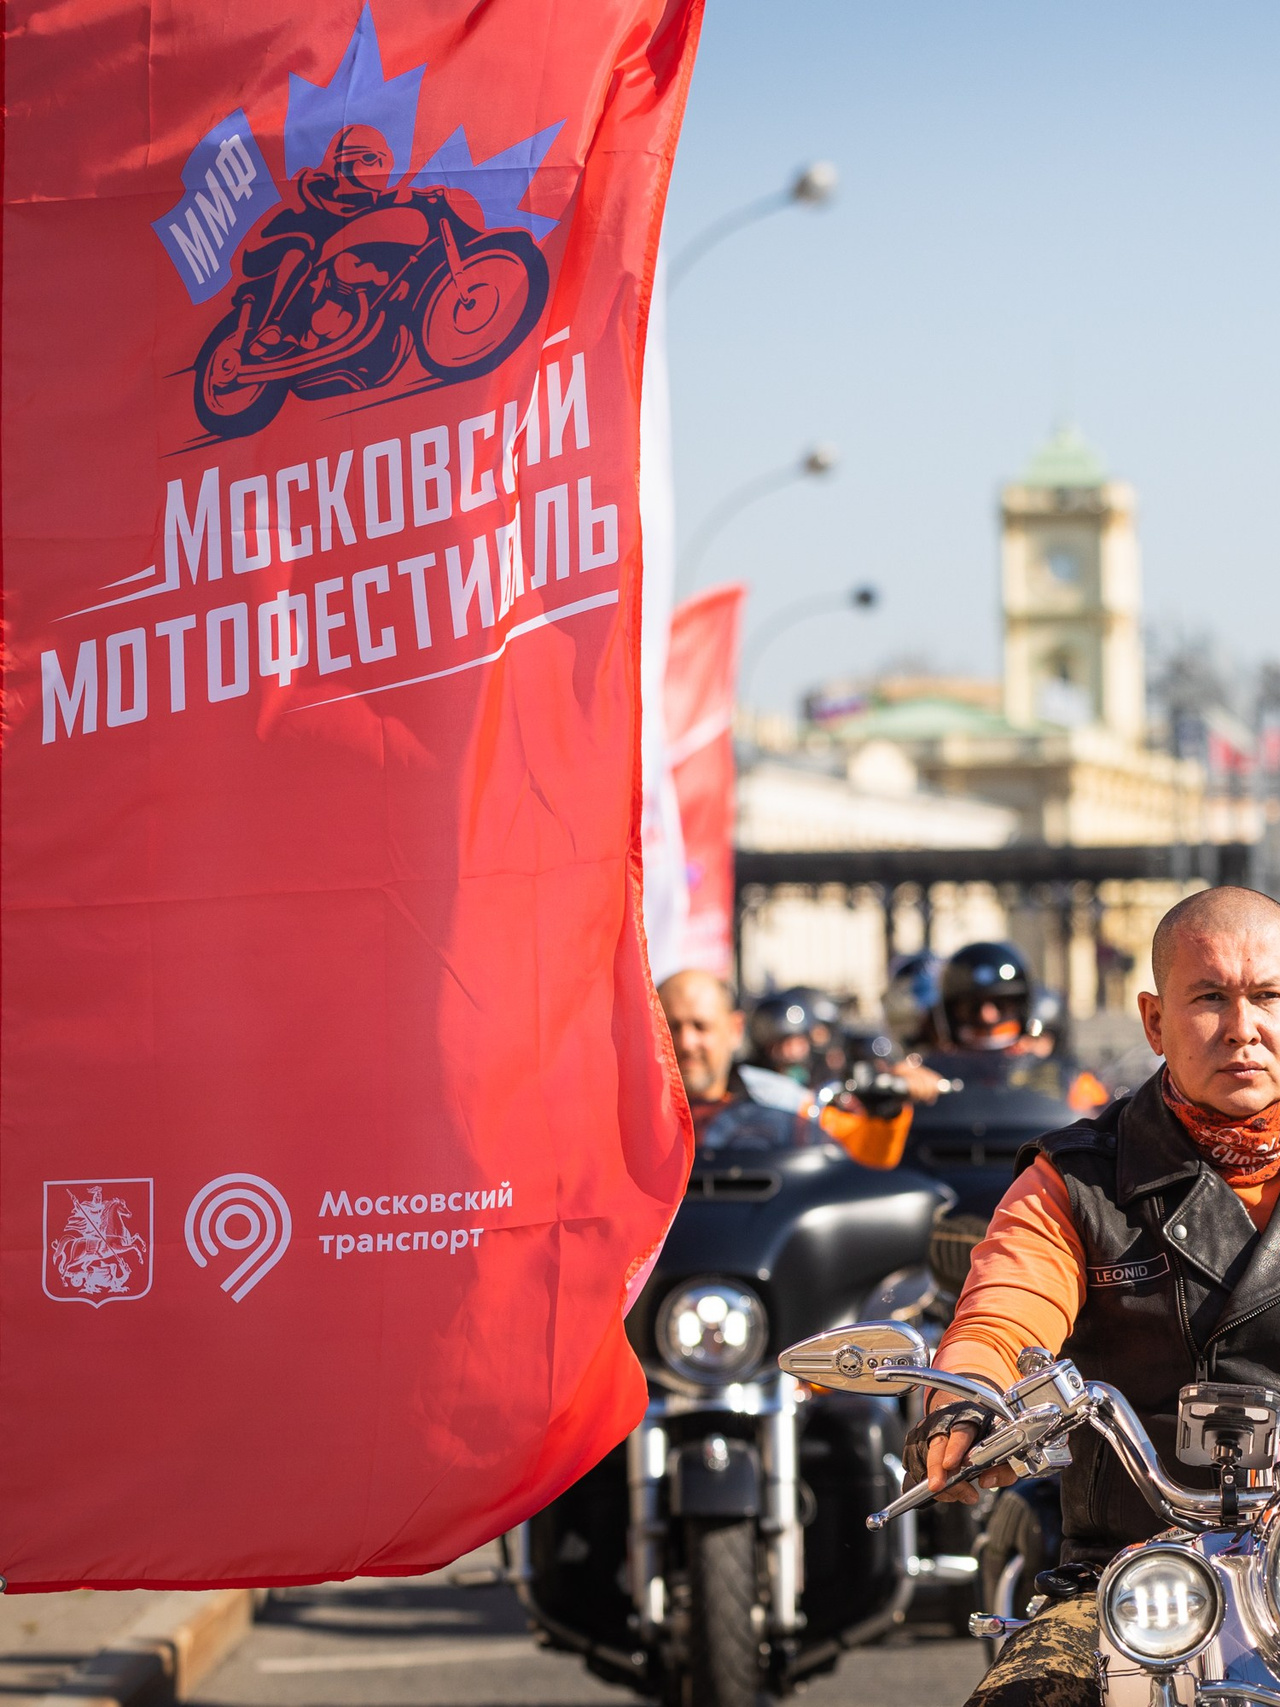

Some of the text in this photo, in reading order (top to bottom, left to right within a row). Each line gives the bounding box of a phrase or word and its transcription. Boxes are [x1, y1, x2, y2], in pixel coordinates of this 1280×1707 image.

[168, 134, 257, 285] ММФ
[318, 1181, 513, 1217] Московский
[318, 1227, 484, 1260] транспорт
[1096, 1265, 1148, 1283] LEONID
